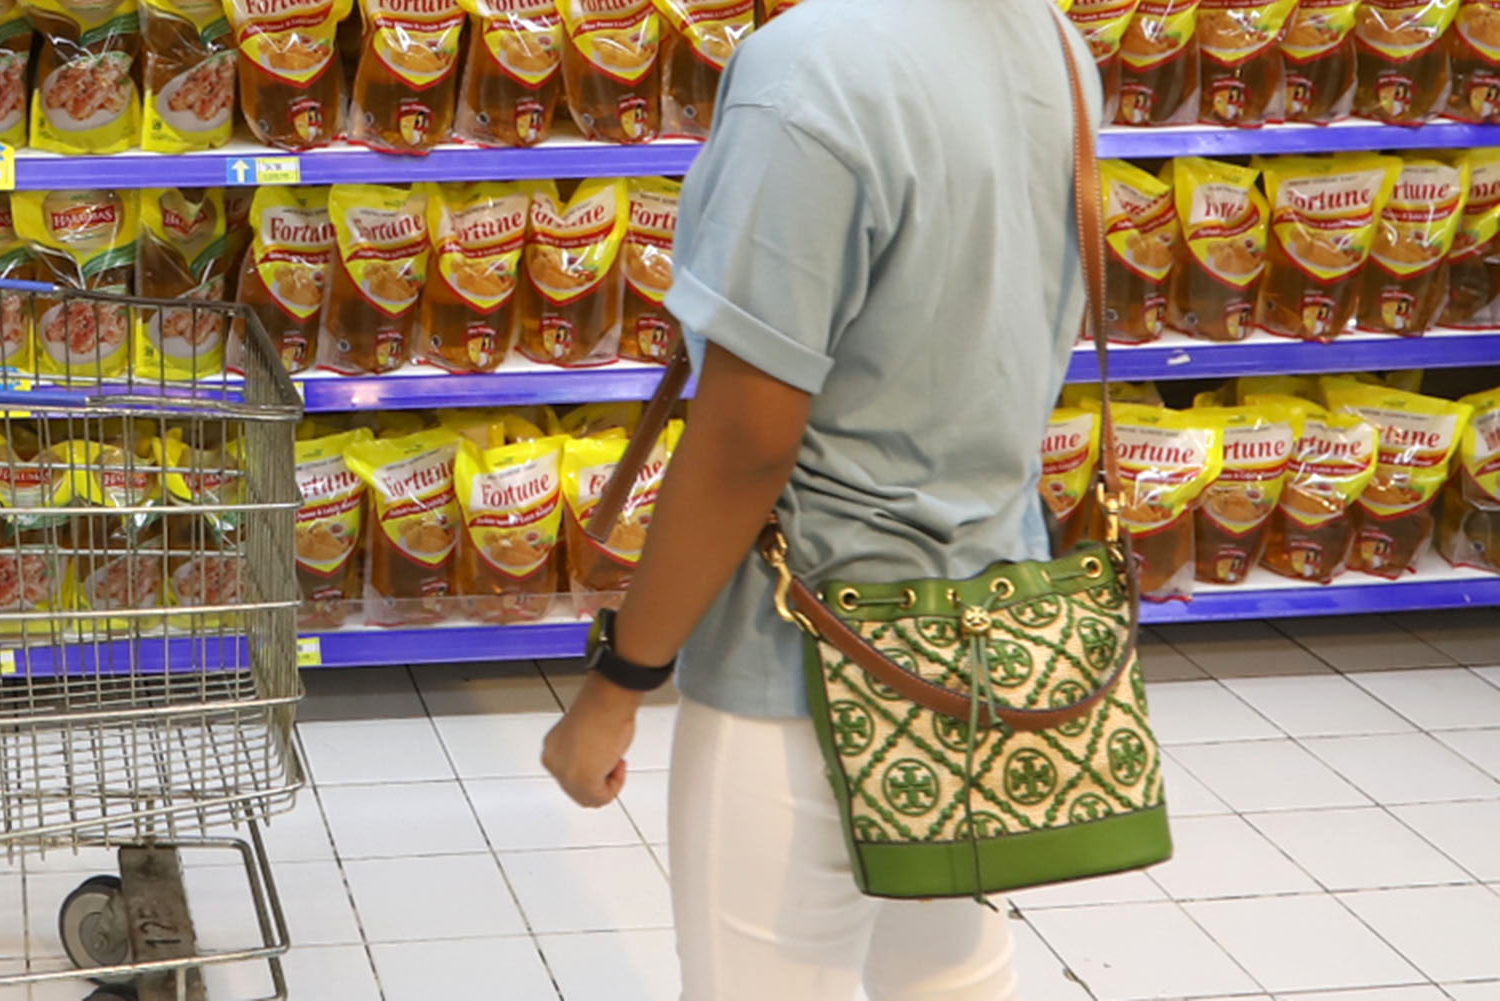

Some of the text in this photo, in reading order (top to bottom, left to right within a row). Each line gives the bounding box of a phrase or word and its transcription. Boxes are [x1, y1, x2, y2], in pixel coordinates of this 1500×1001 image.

[1392, 181, 1450, 201] rtune
[631, 200, 678, 229] Fort
[1114, 440, 1196, 465] ortune
[1223, 437, 1287, 460] rtune
[482, 473, 549, 507] Fortune
